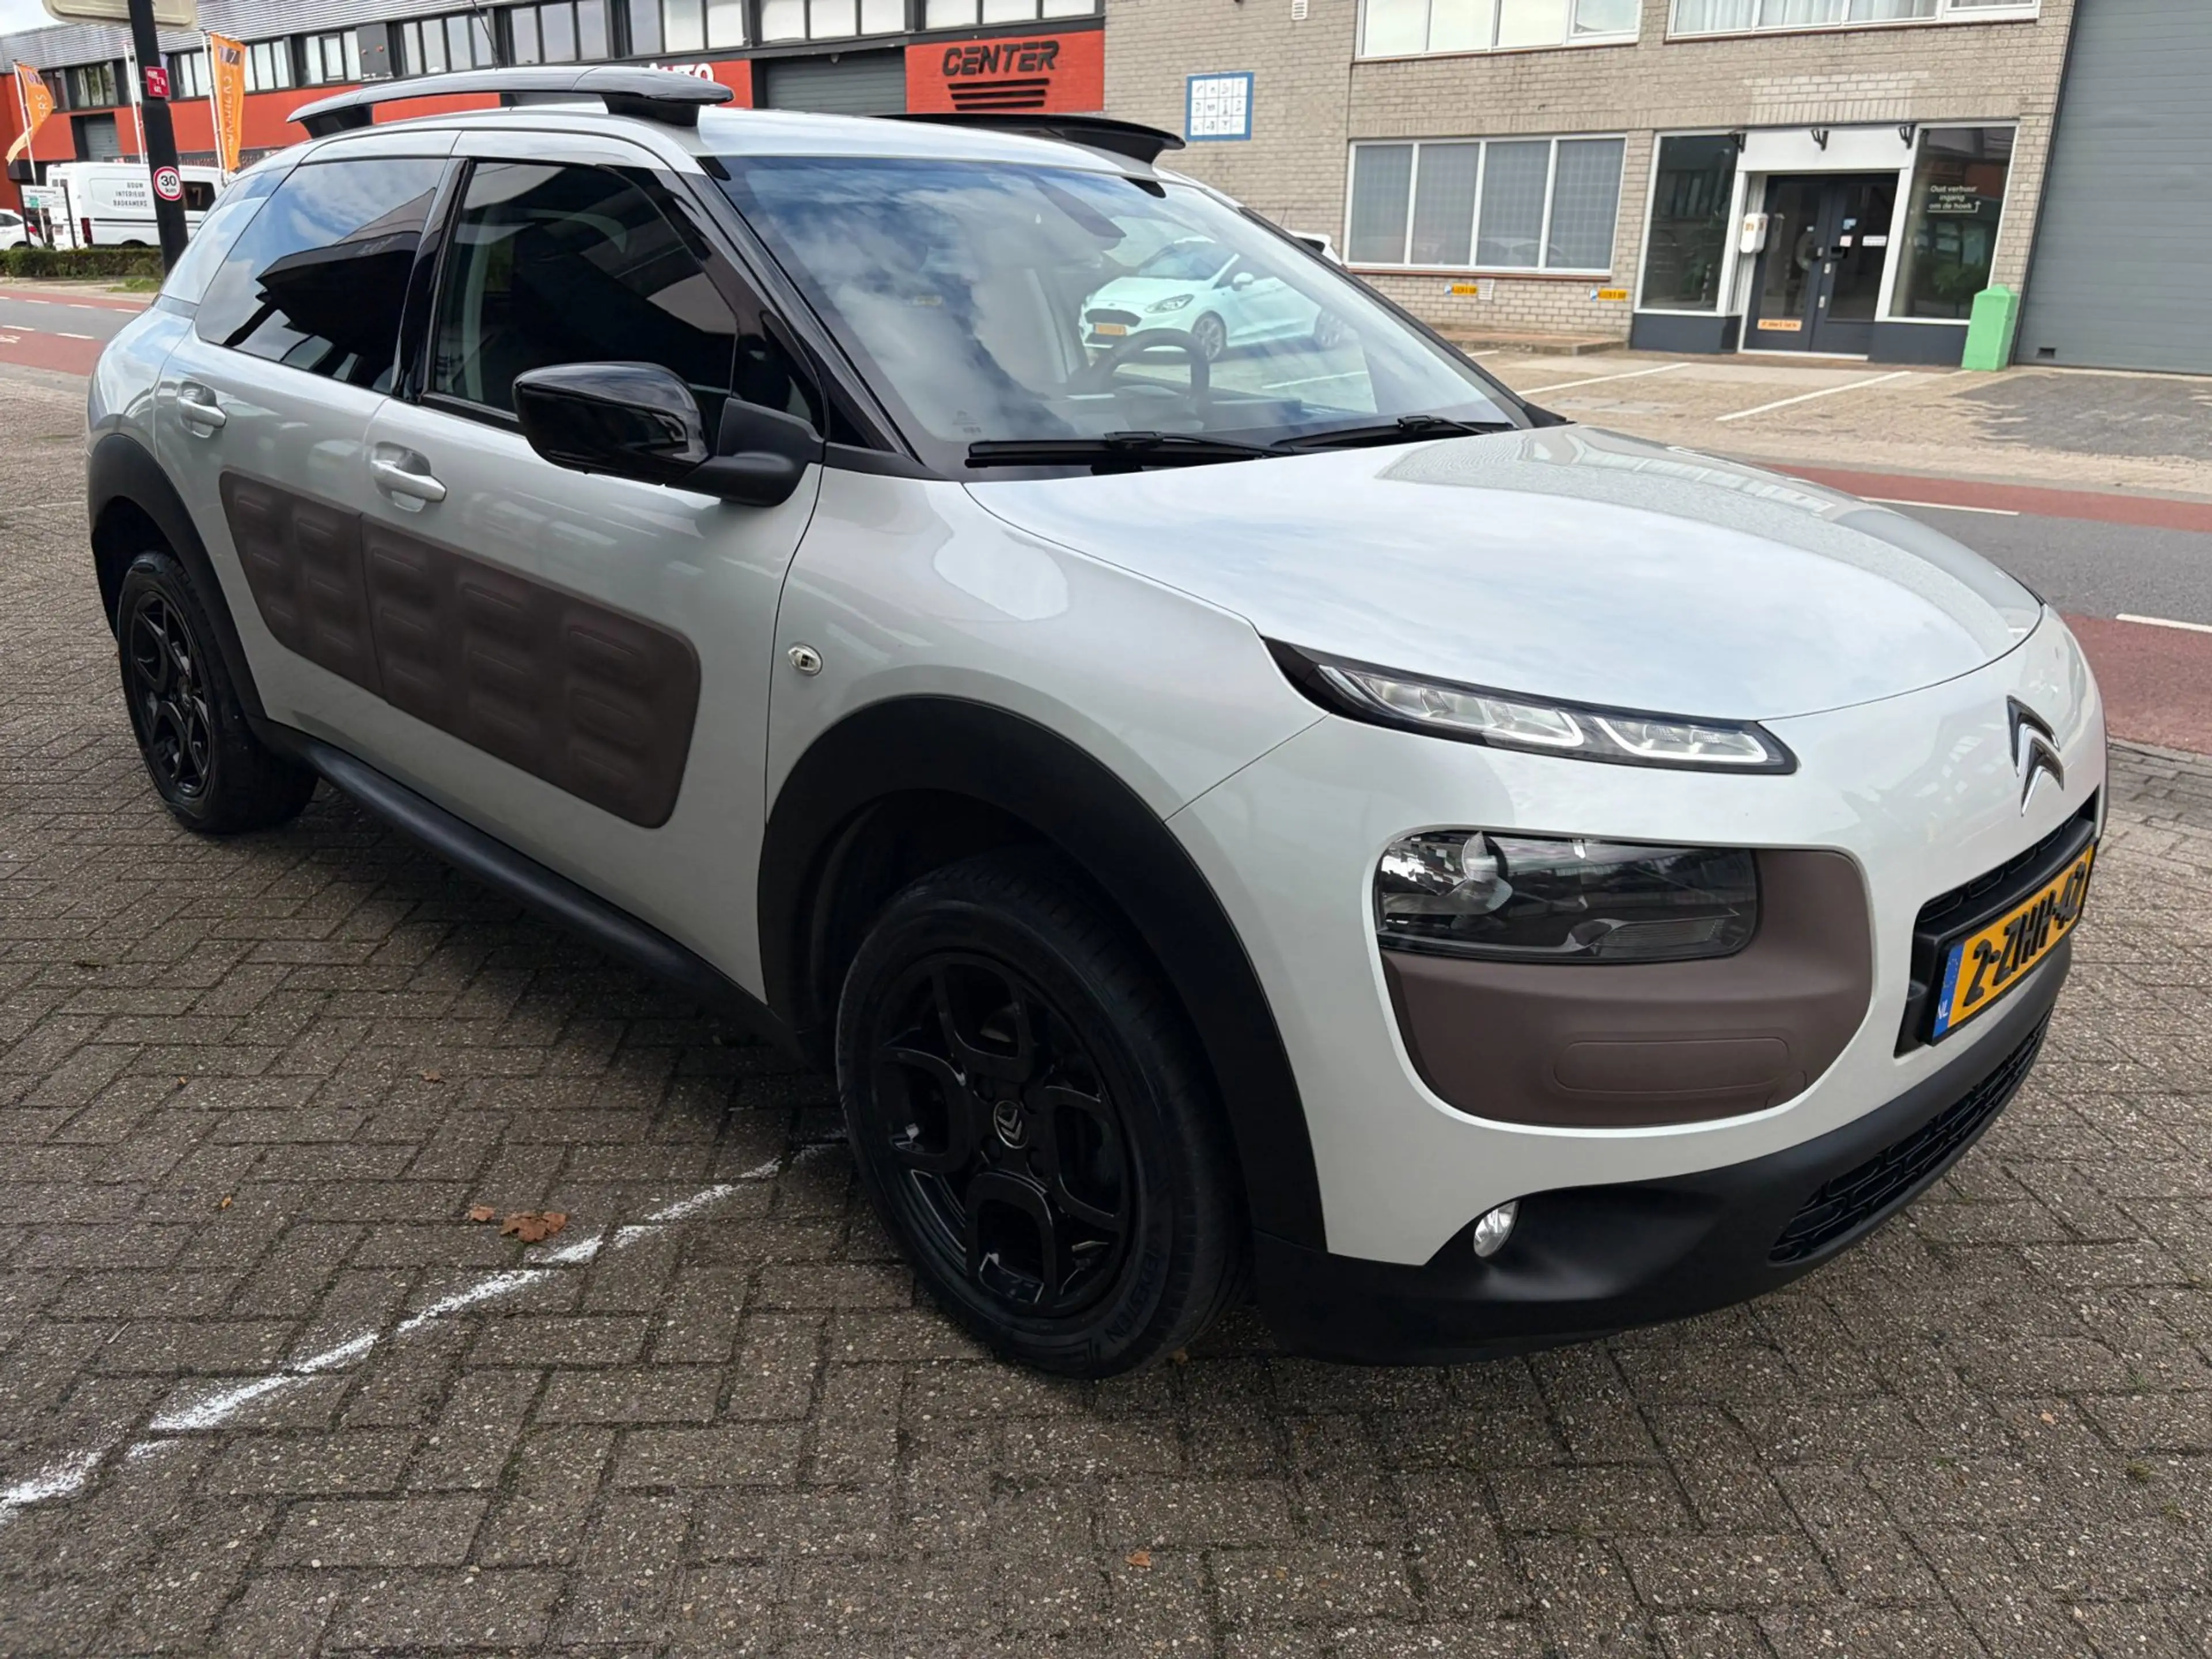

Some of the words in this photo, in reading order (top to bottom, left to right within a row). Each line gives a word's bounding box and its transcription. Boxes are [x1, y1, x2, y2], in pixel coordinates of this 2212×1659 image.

[942, 40, 1059, 76] CENTER
[161, 175, 177, 186] 30
[1937, 999, 1948, 1020] NL
